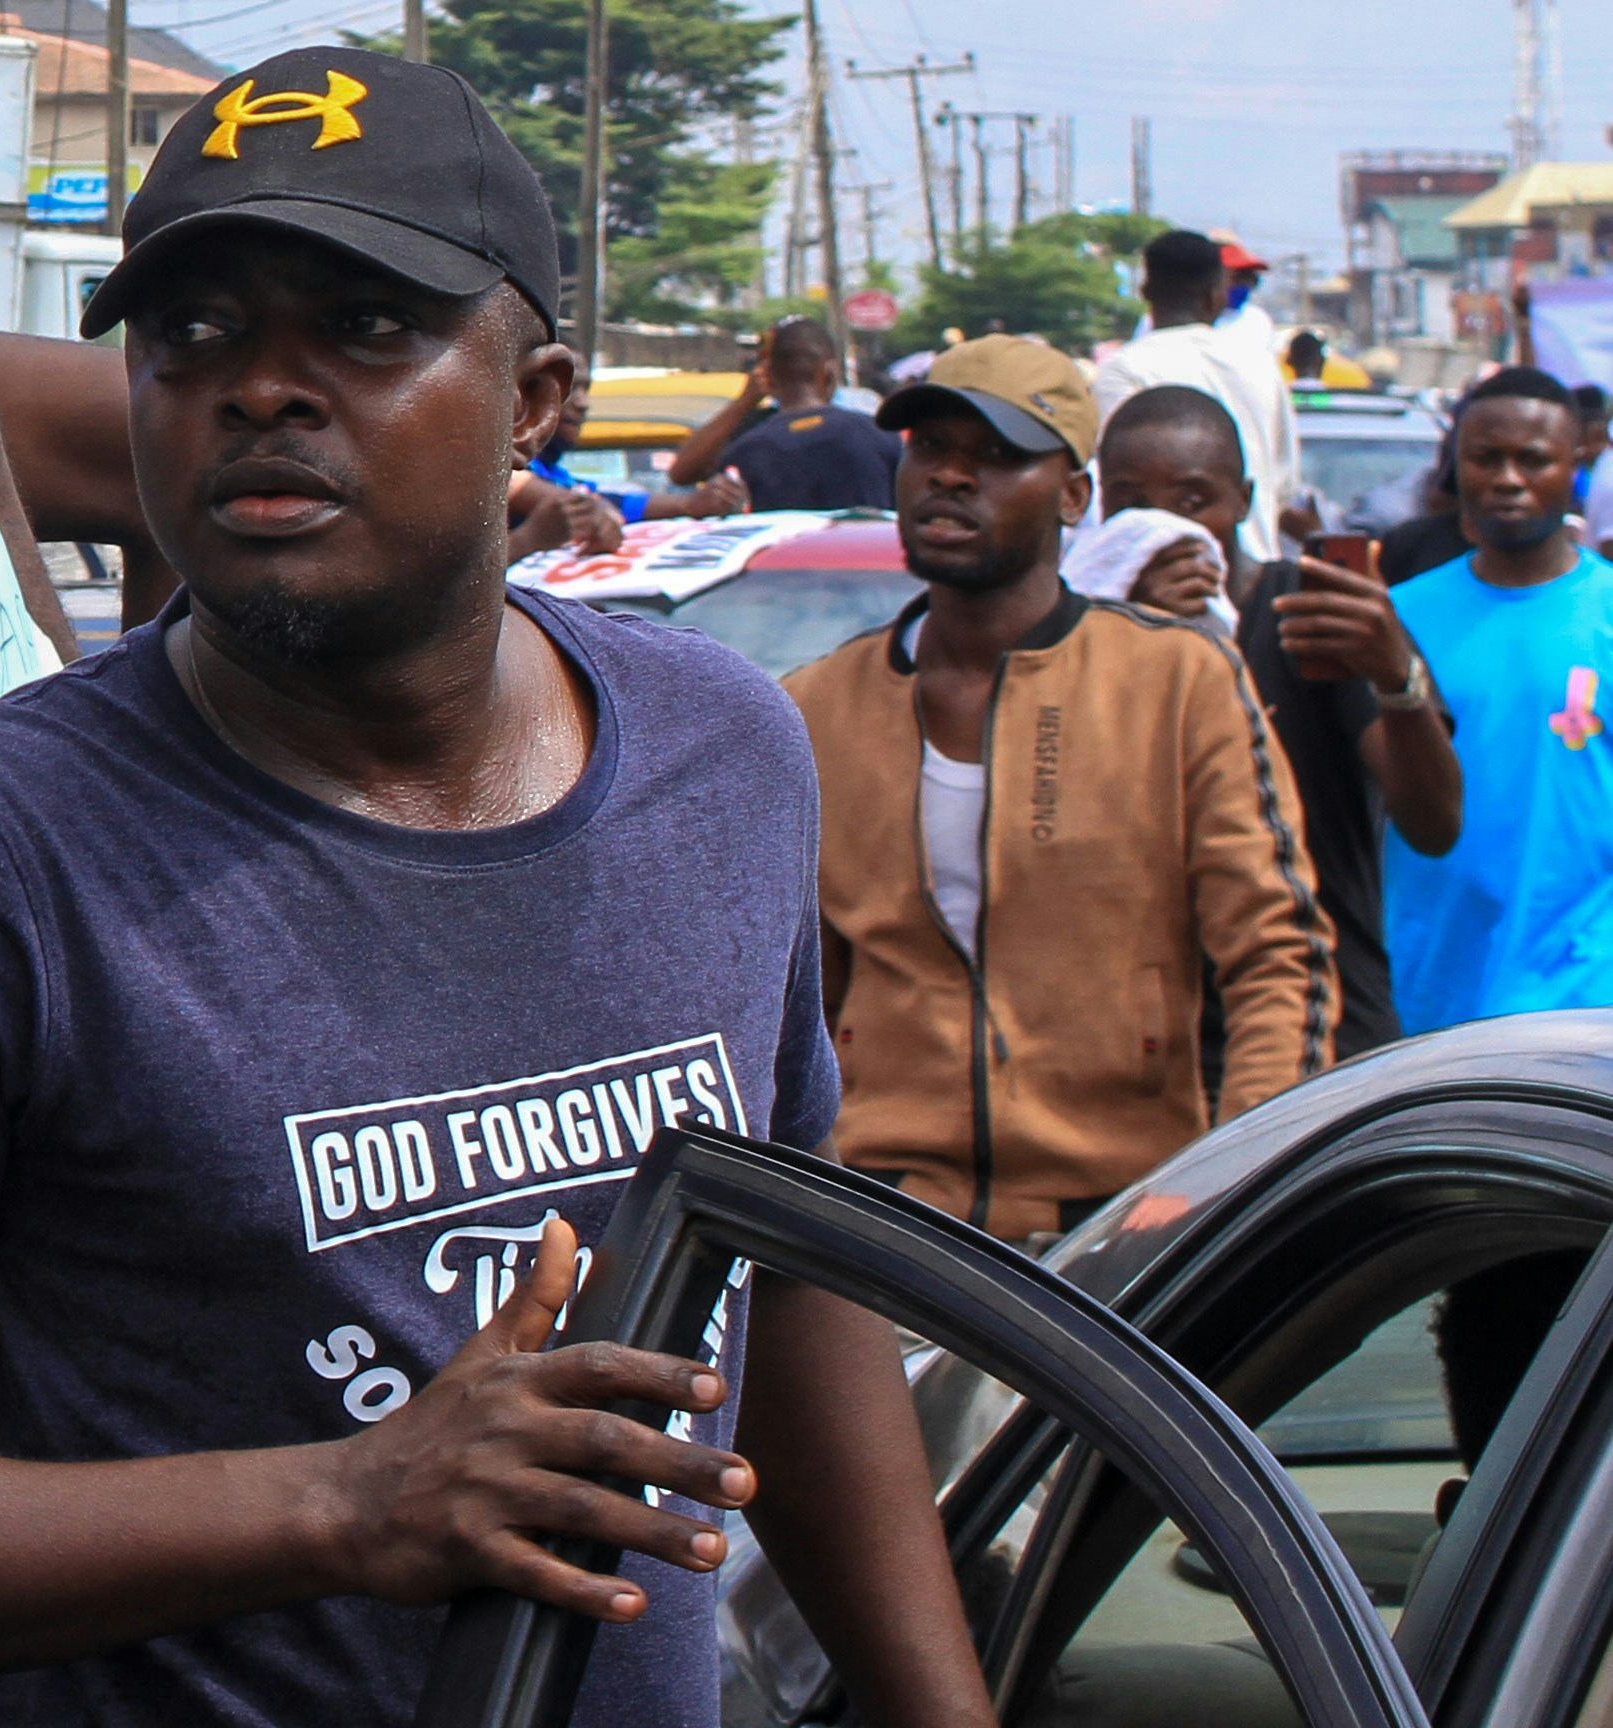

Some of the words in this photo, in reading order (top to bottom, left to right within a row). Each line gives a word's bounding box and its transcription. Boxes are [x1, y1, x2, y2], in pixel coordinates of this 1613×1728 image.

[53, 176, 109, 195] PEP
[309, 1120, 436, 1221] GOD
[446, 1057, 725, 1190] FORGIVES
